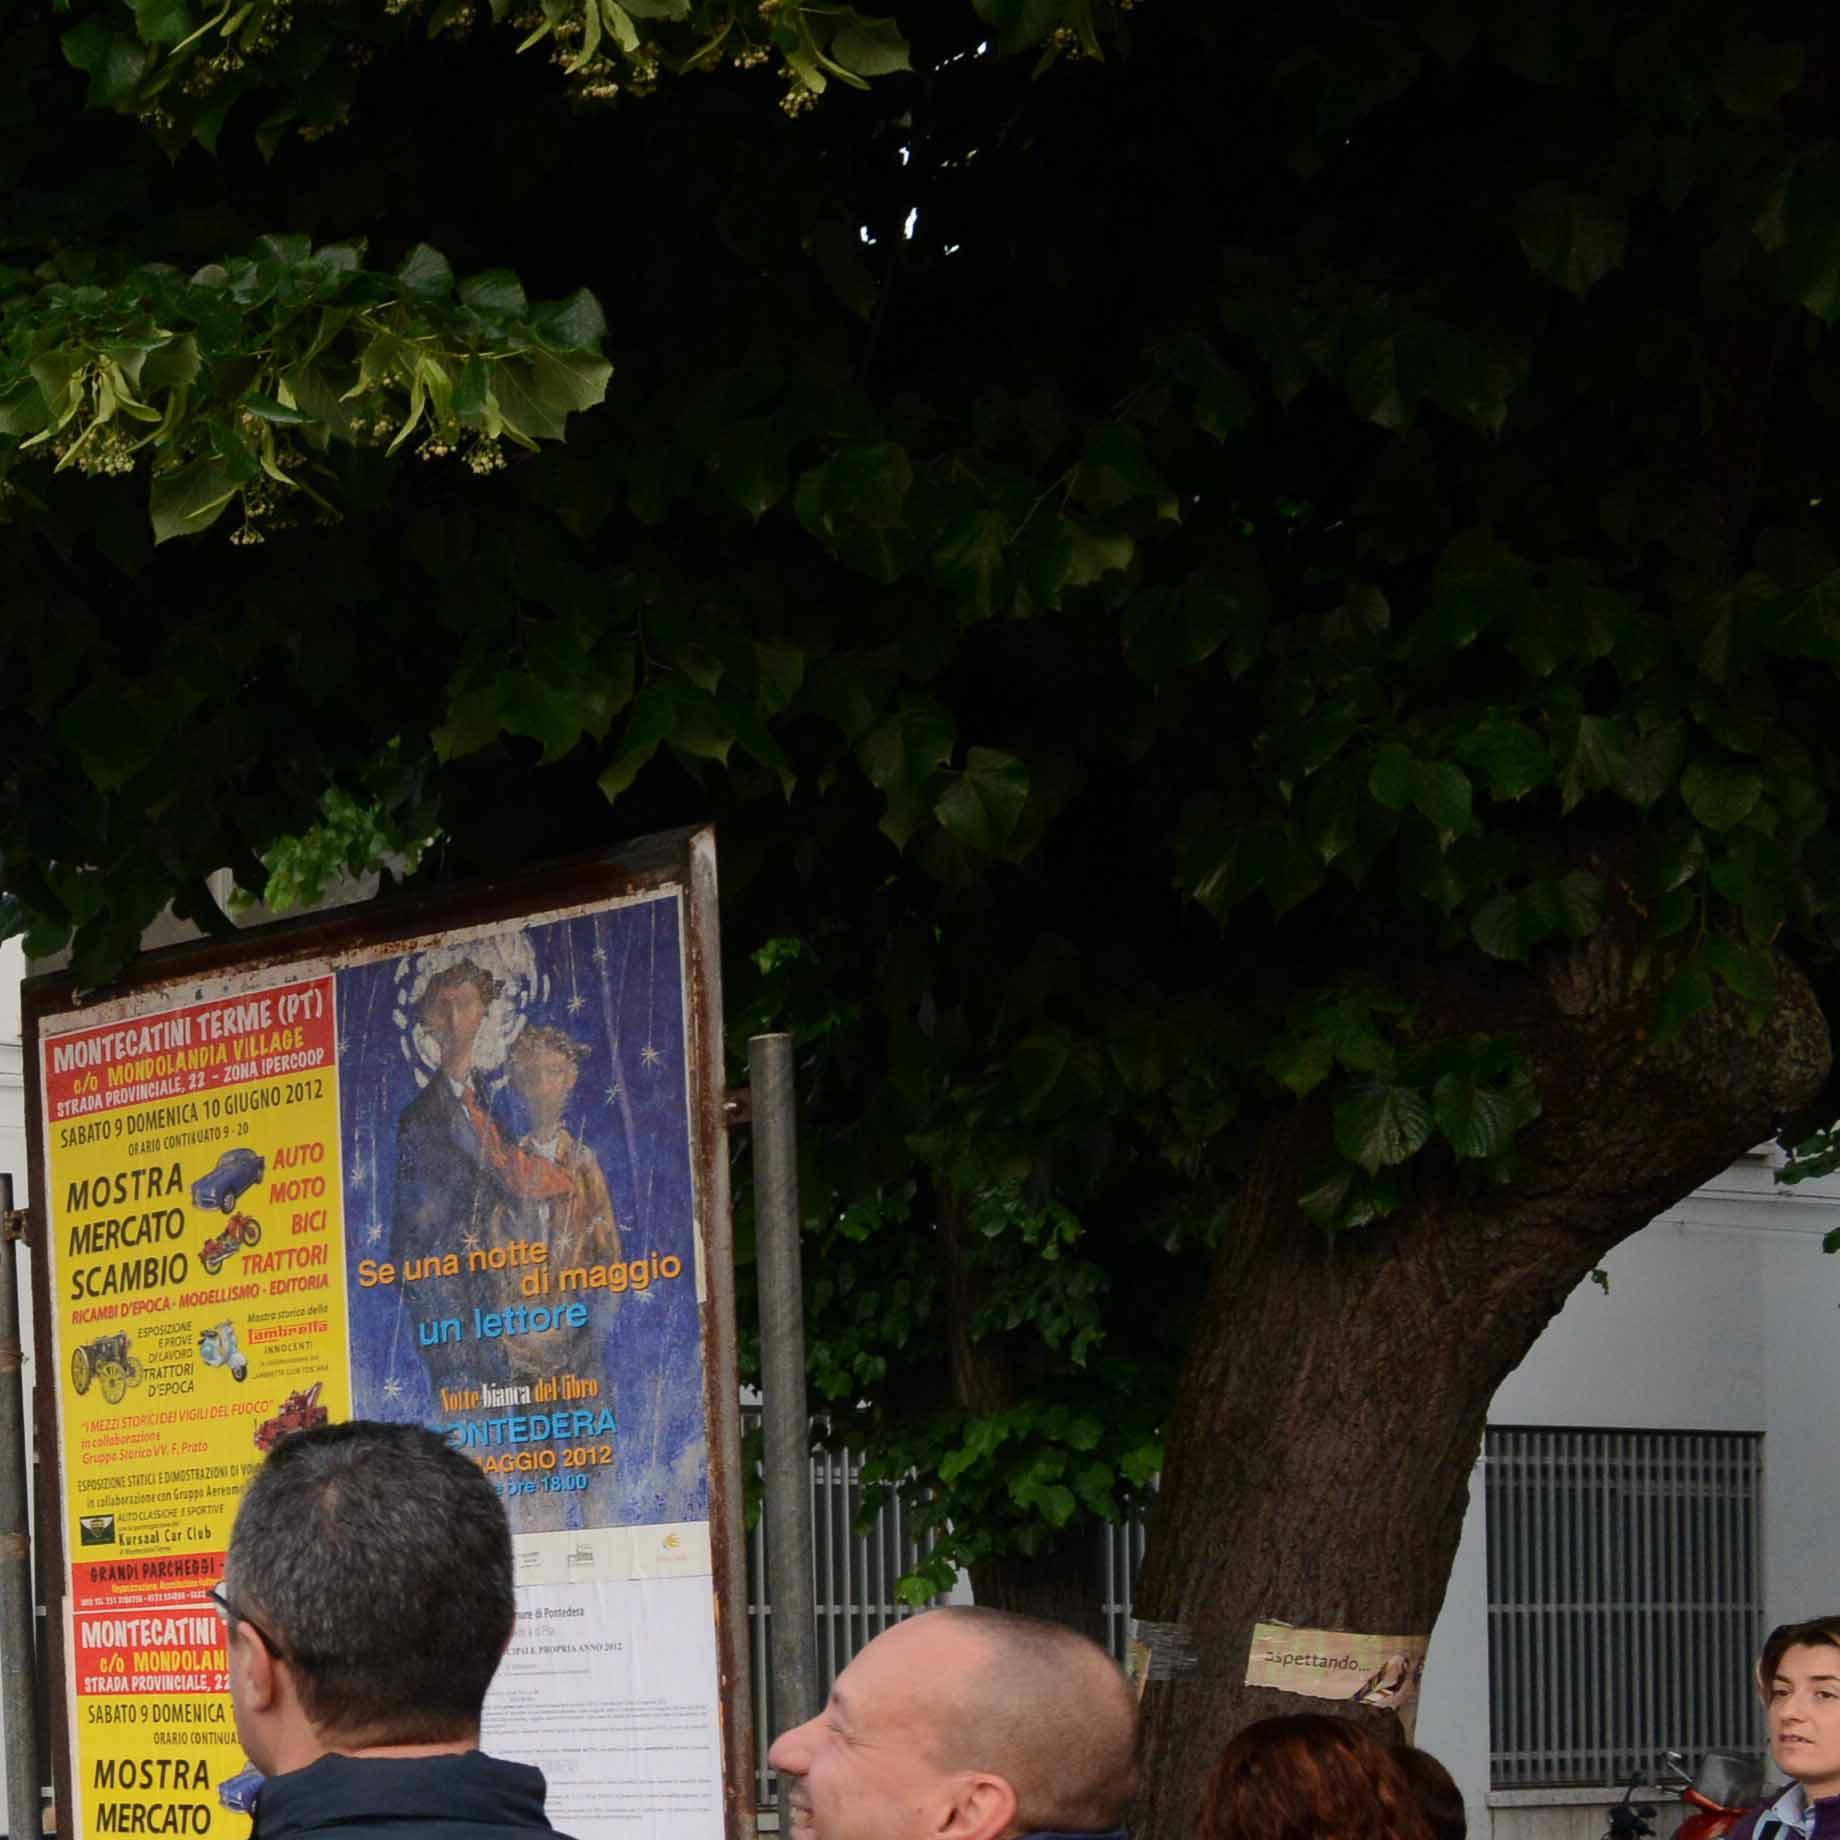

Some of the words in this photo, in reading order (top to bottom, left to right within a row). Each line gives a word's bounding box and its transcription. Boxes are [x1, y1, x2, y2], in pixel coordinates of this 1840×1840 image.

[53, 1017, 191, 1074] MONTECATINI
[196, 999, 273, 1042] TERME
[278, 988, 324, 1027] (PT)
[73, 1071, 99, 1094] c/o
[107, 1046, 227, 1088] MONDOLANDIA
[233, 1025, 305, 1058] VILLAGE
[57, 1091, 104, 1118] STRADA
[105, 1077, 186, 1111] PROVINCIALE,
[188, 1073, 205, 1089] 22
[223, 1061, 258, 1082] ZONA
[261, 1048, 325, 1075] IPERCOOP
[60, 1120, 112, 1149] SABATO
[114, 1118, 123, 1137] 9
[126, 1104, 199, 1136] DOMENICA
[204, 1100, 220, 1119] 10
[224, 1087, 281, 1117] GIUGNO
[286, 1079, 323, 1104] 2012
[128, 1138, 161, 1157] ORARIO
[163, 1129, 221, 1153] CONTINUATO
[222, 1128, 230, 1140] 9
[237, 1123, 250, 1137] 20
[272, 1142, 325, 1171] AUTO
[66, 1162, 184, 1213] MOSTRA
[269, 1176, 326, 1205] MOTO
[68, 1207, 186, 1257] MERCATO
[291, 1209, 327, 1236] BICI
[241, 1243, 329, 1277] TRATTORI
[358, 1259, 397, 1289] Se
[404, 1252, 460, 1282] una
[469, 1238, 549, 1272] notte
[519, 1266, 551, 1297] di
[559, 1250, 683, 1294] maggio
[70, 1252, 189, 1300] SCAMBIO
[71, 1301, 118, 1325] RICAMBI
[120, 1295, 170, 1319] D'EPOCA
[178, 1282, 260, 1309] MODELLISMO
[269, 1273, 329, 1297] EDITORIA
[137, 1320, 193, 1339] ESPOSIZIONE
[419, 1316, 464, 1346] un
[475, 1300, 590, 1340] lettore
[158, 1348, 193, 1362] LAVORO
[165, 1335, 193, 1347] PROVE
[143, 1363, 194, 1381] TRATTORI
[147, 1381, 195, 1398] D'EPOCA
[440, 1387, 480, 1413] Notte
[481, 1381, 532, 1408] bianca
[533, 1378, 559, 1403] del
[561, 1374, 600, 1401] libro
[89, 1416, 121, 1433] MEZZI
[120, 1412, 160, 1430] STORICI
[177, 1407, 209, 1424] VIGILI
[209, 1404, 230, 1420] DEL
[562, 1446, 614, 1468] 2012
[78, 1476, 126, 1492] ESPOSIZIONE
[173, 1487, 205, 1502] Gruppo
[507, 1478, 538, 1496] ore
[541, 1471, 589, 1493] 18.00
[119, 1530, 160, 1546] Kursaal
[164, 1529, 182, 1543] Car
[186, 1525, 212, 1541] Club
[90, 1562, 139, 1583] GRANDI
[142, 1557, 216, 1579] PARCHEGGI
[543, 1604, 585, 1618] Pontedera
[81, 1616, 217, 1649] MONTECATINI
[100, 1653, 125, 1673] c/o
[133, 1649, 230, 1672] MONDOLAN
[84, 1675, 130, 1693] STRADA
[131, 1673, 212, 1692] PROVINCIALE,
[88, 1703, 137, 1724] SABATO
[140, 1704, 149, 1723] 9
[152, 1703, 226, 1724] DOMENICA
[153, 1731, 188, 1745] ORARIO
[93, 1759, 210, 1790] MOSTRA
[96, 1803, 212, 1835] MERCATO
